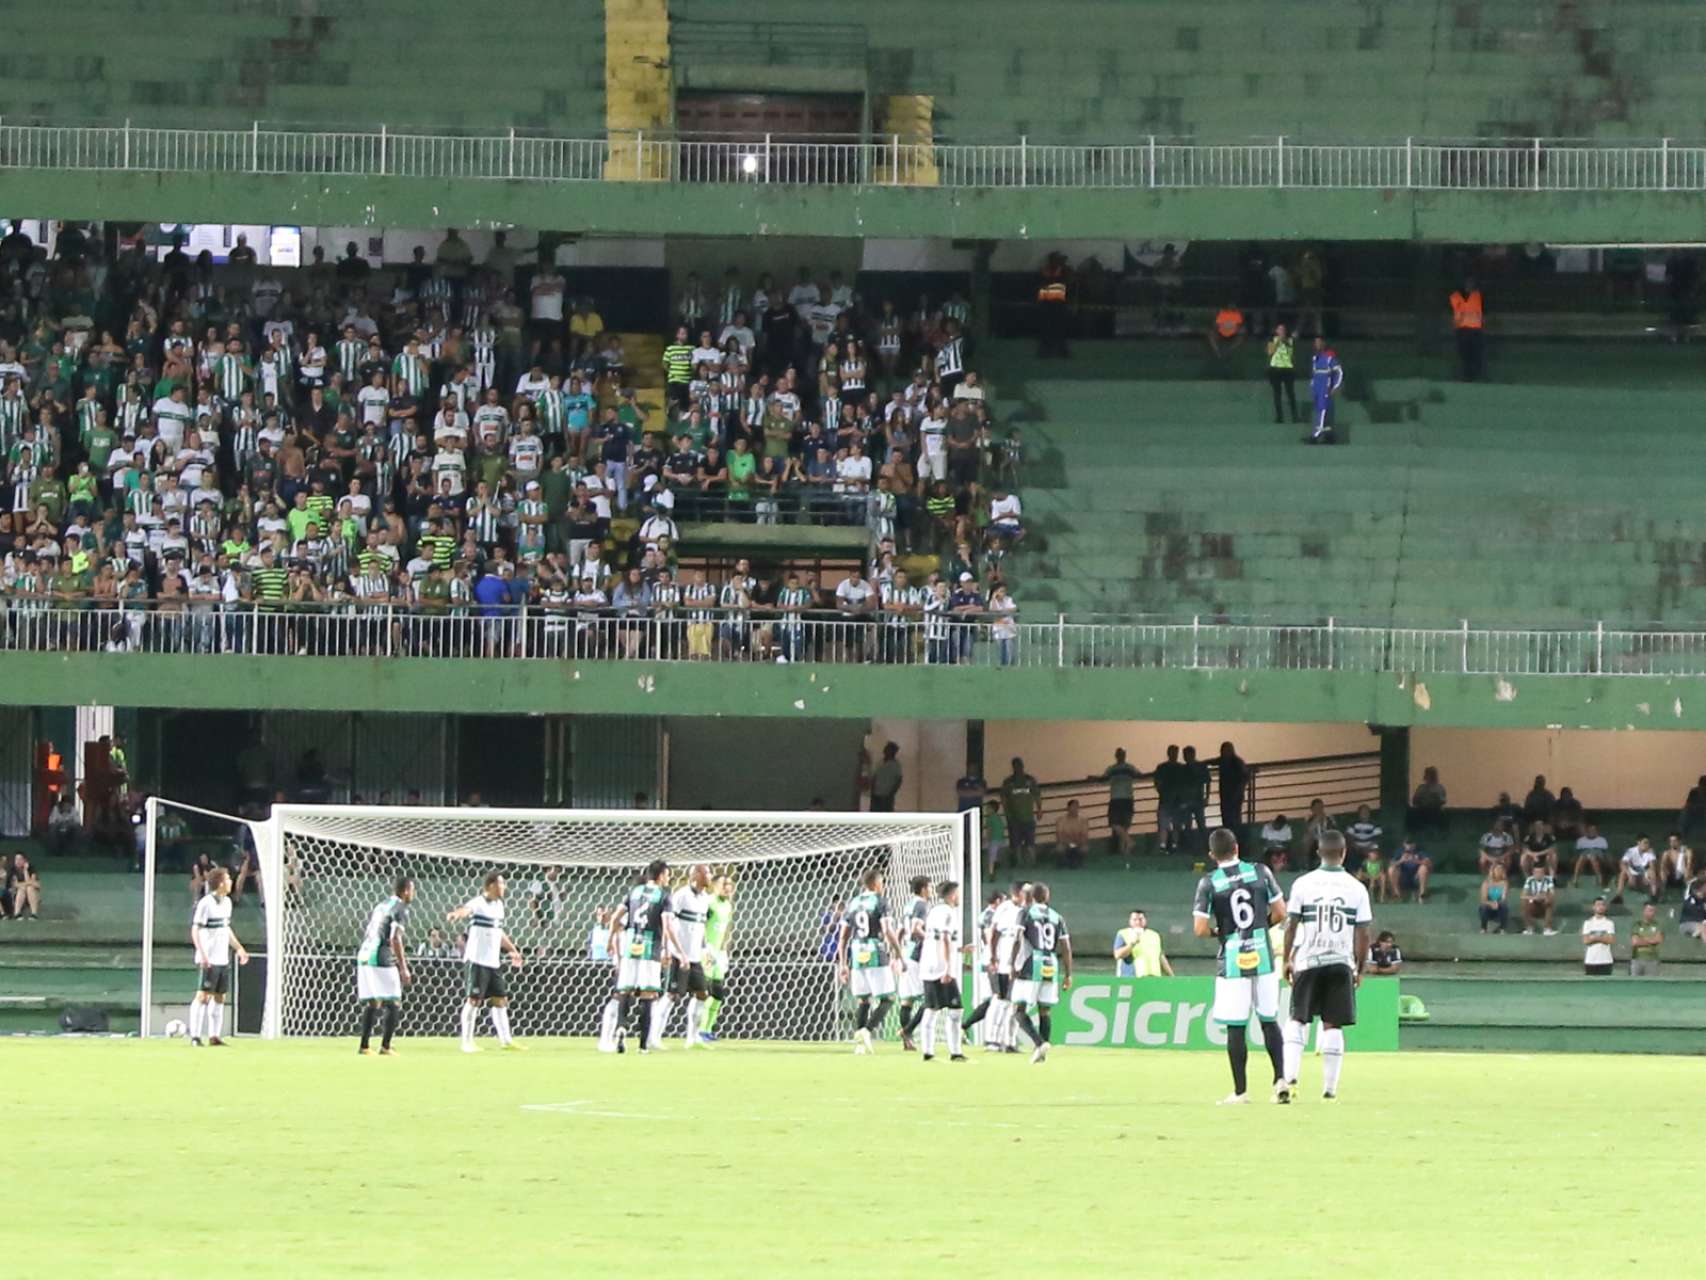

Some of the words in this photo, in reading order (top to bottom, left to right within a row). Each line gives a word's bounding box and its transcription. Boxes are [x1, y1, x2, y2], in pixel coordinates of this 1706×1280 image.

[855, 911, 870, 938] 9
[1230, 889, 1255, 929] 6
[1313, 896, 1346, 934] 16
[1034, 920, 1056, 950] 19
